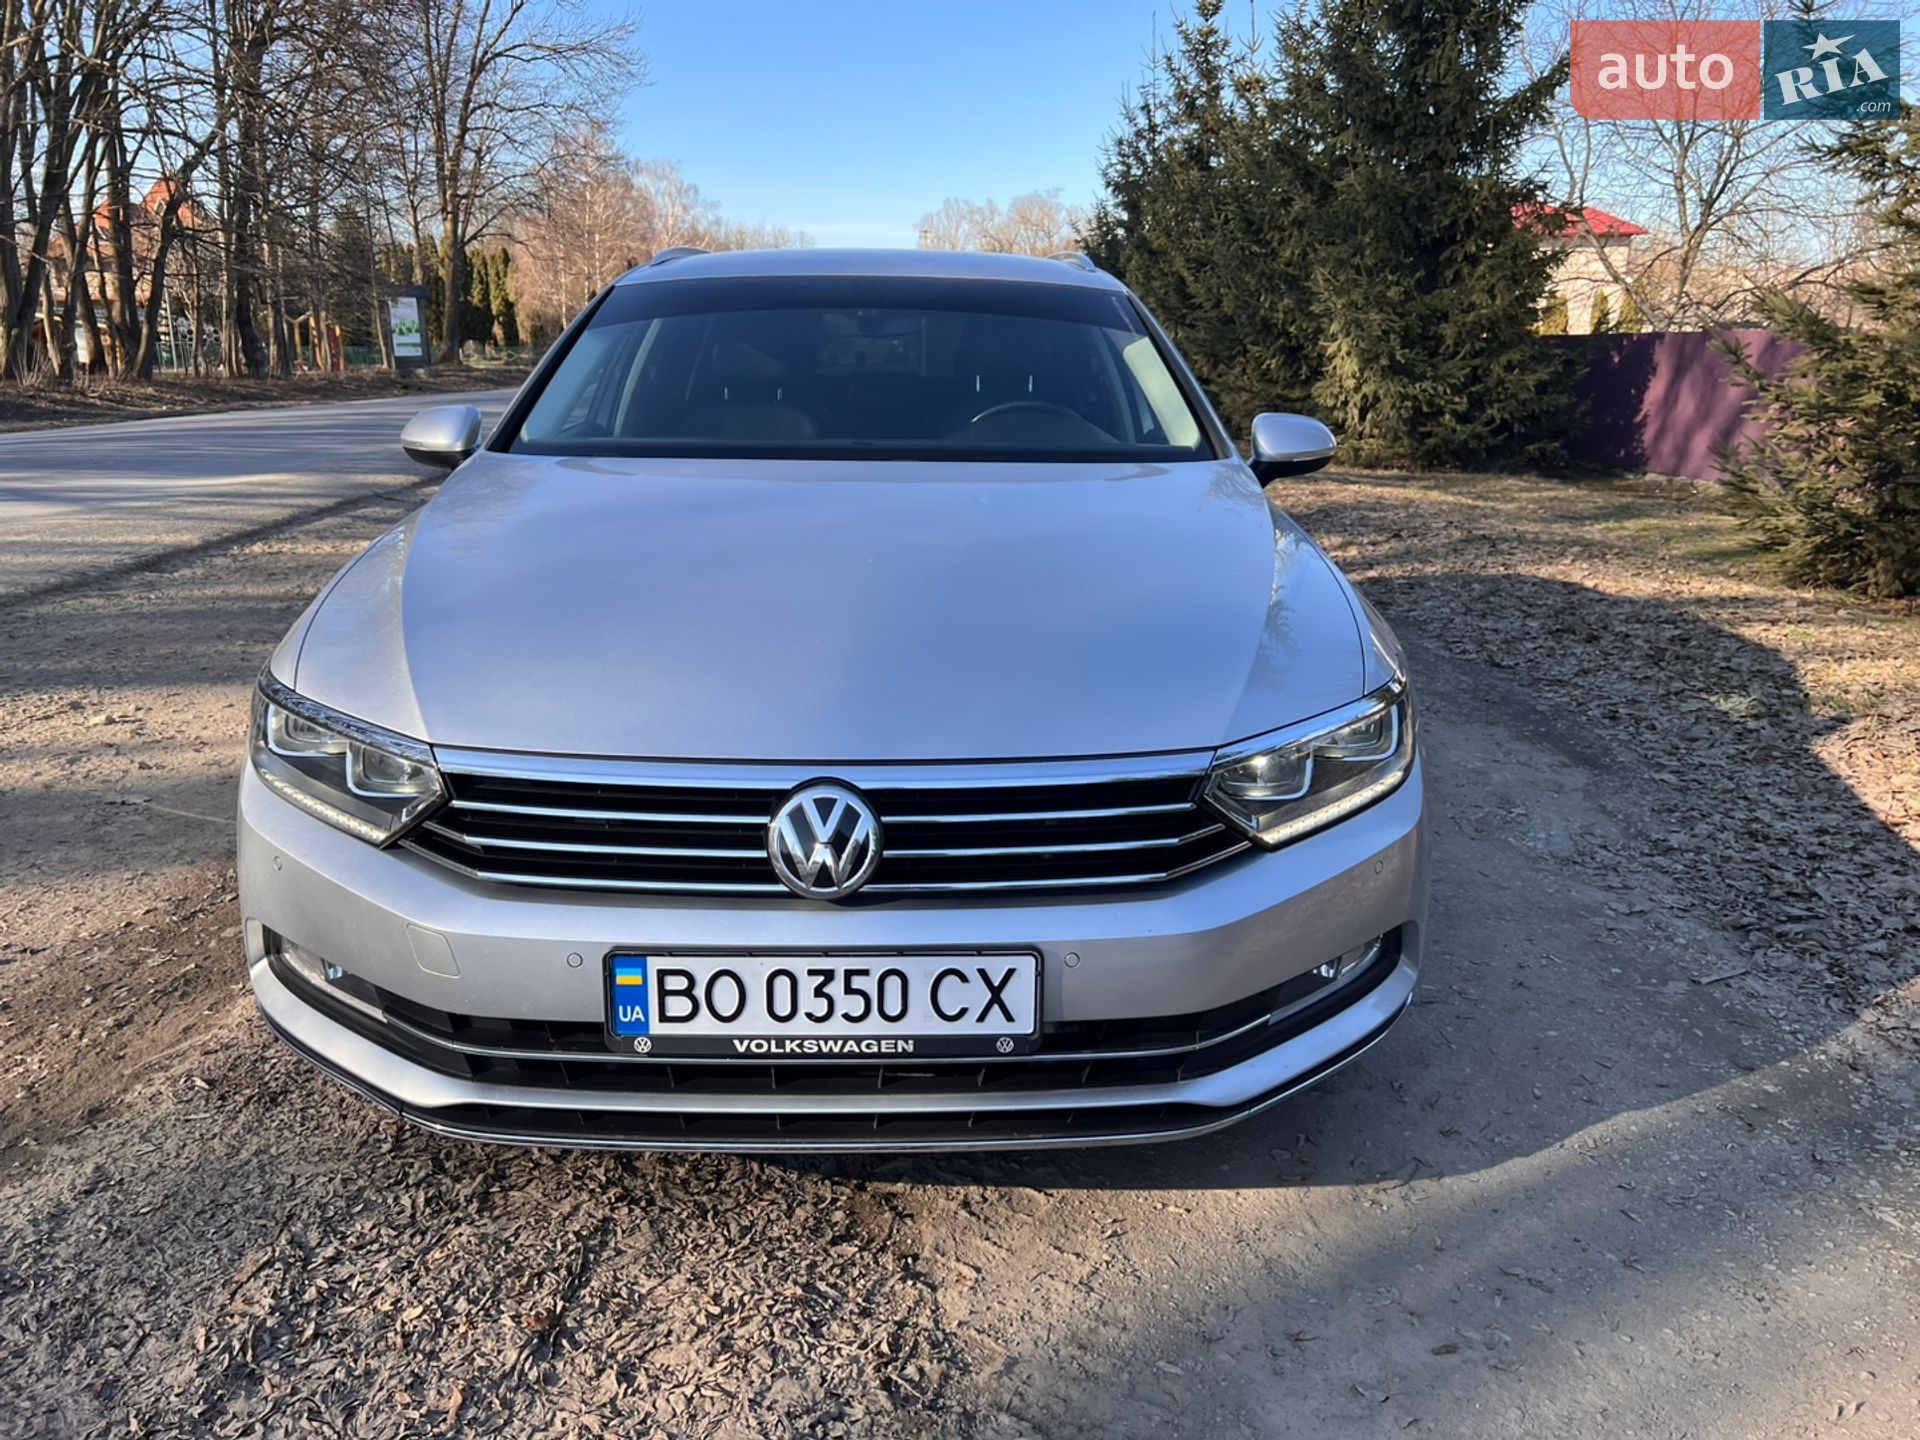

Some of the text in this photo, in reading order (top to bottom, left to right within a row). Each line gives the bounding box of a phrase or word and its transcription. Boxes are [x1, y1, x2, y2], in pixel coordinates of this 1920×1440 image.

[656, 967, 1017, 1023] BO 0350 CX
[618, 1004, 646, 1023] UA
[732, 1038, 914, 1054] VOLKSWAGEN
